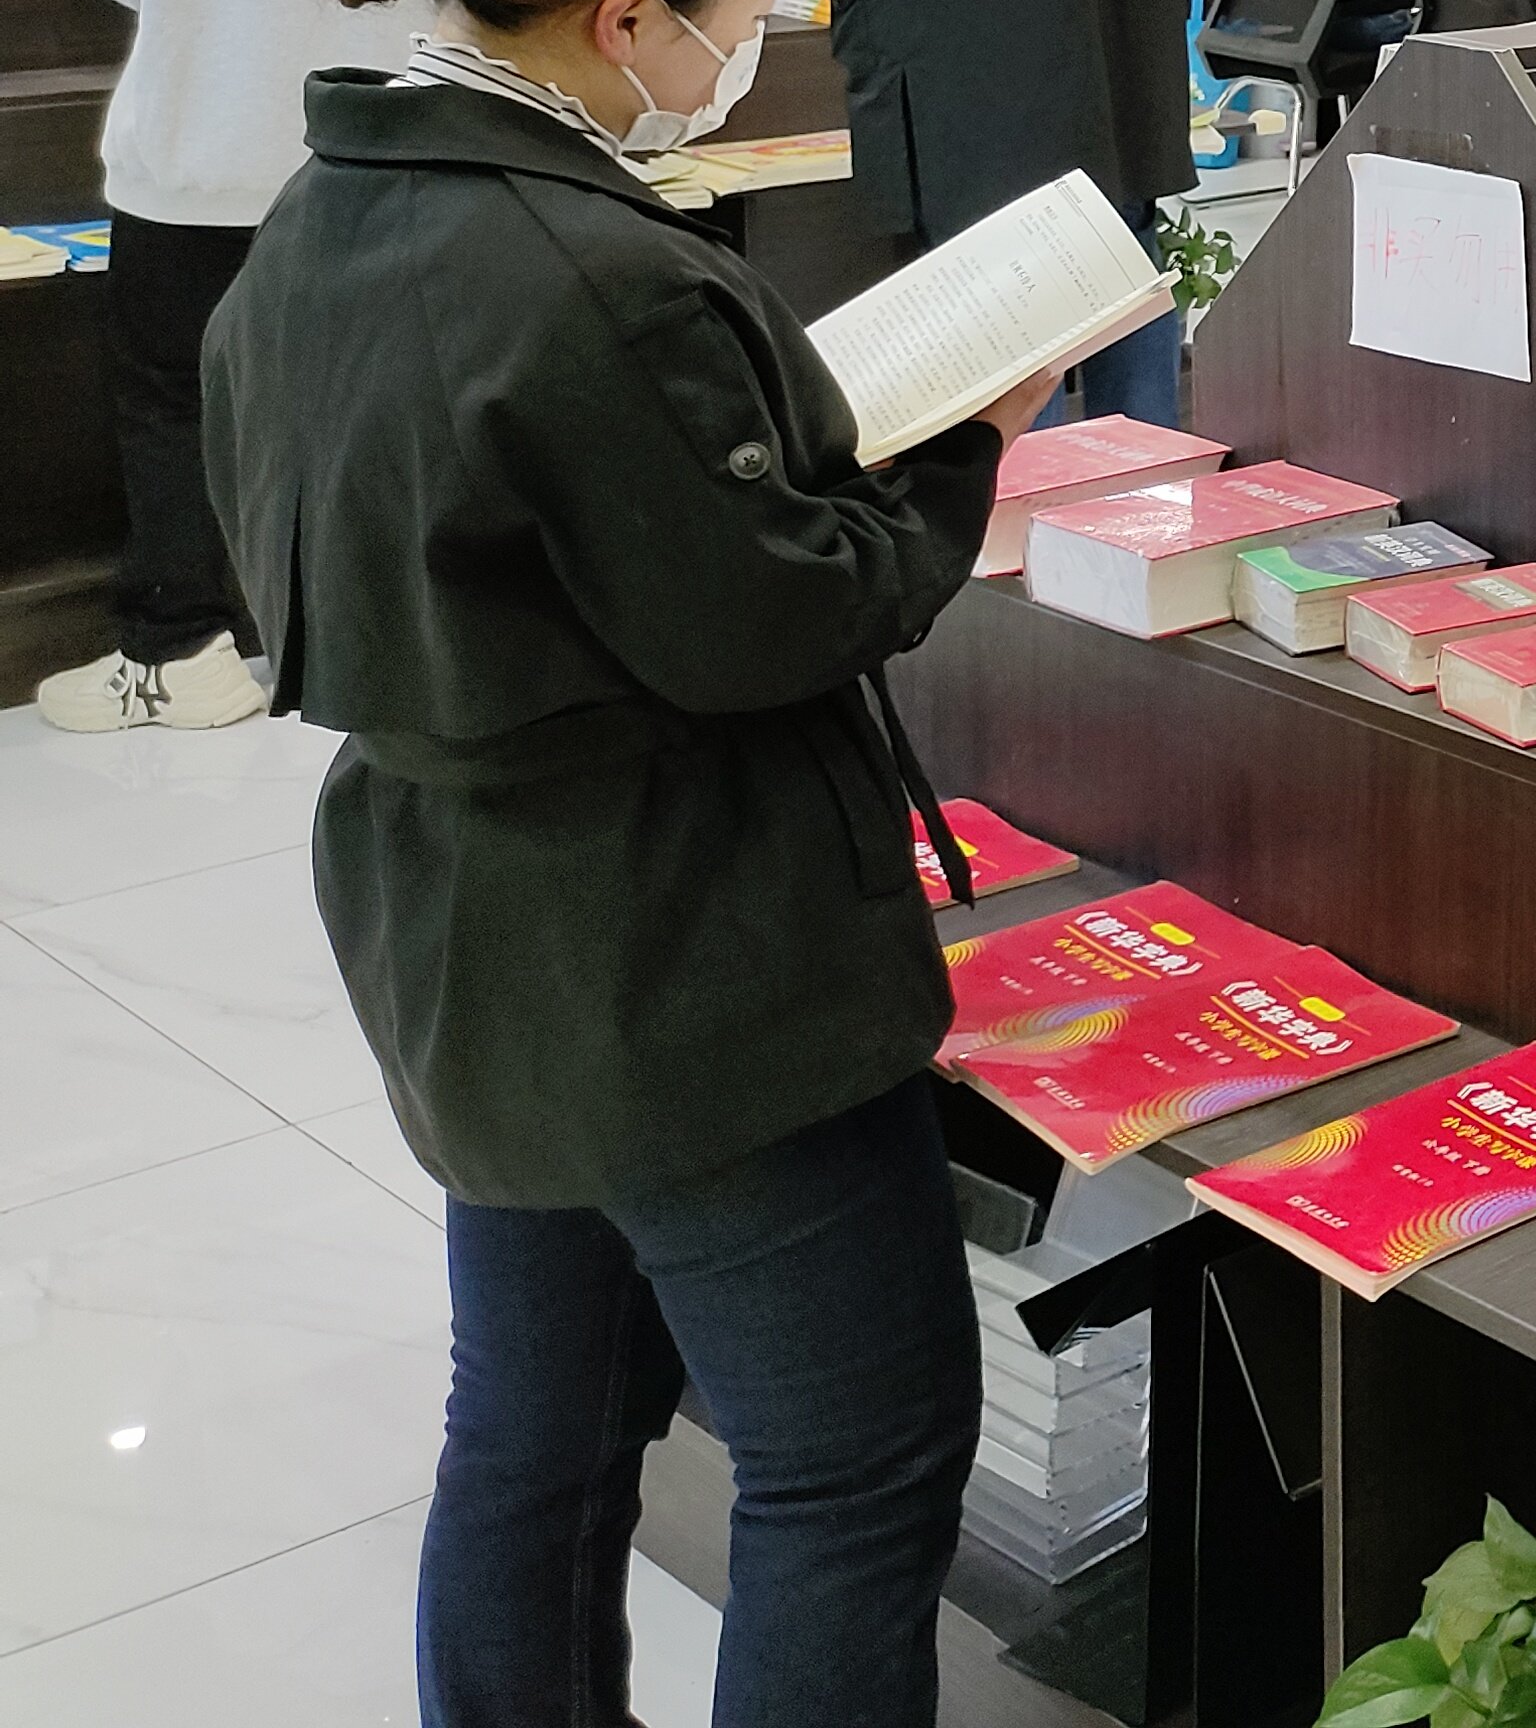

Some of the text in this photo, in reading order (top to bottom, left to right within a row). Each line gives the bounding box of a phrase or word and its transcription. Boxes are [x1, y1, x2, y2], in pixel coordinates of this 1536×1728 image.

[1074, 910, 1204, 977] 《新华字典》
[1220, 980, 1353, 1056] 《新华字典》
